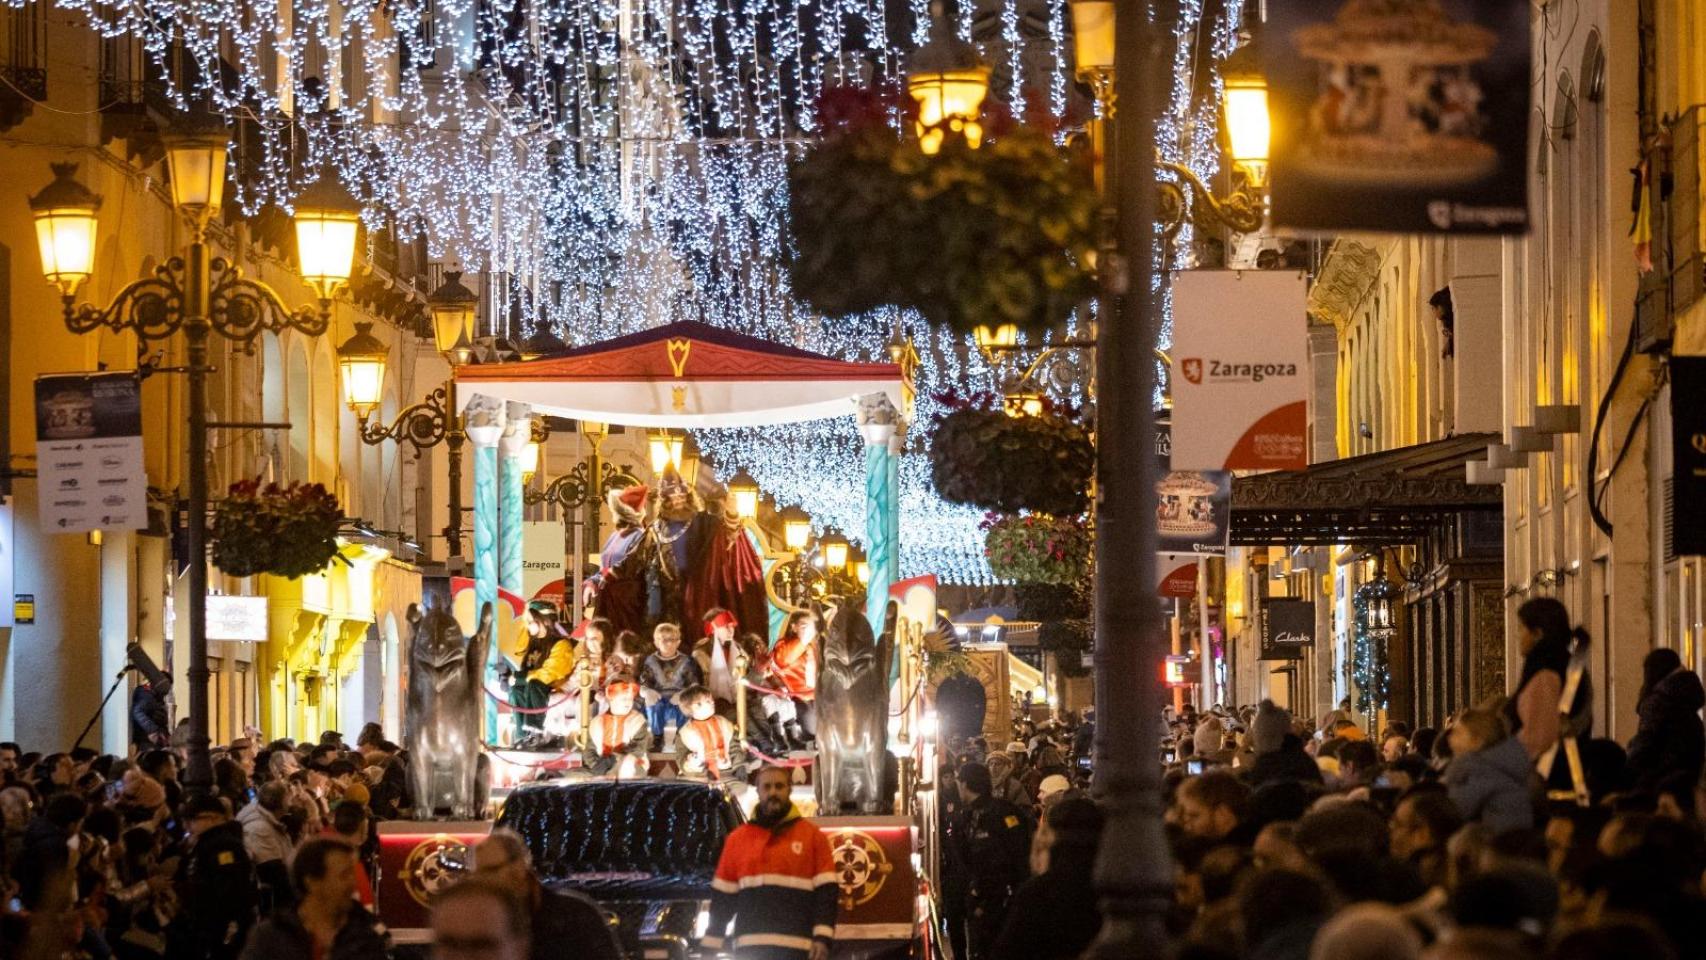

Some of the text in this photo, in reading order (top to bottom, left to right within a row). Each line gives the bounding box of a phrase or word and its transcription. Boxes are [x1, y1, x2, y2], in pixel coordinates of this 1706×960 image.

[1210, 361, 1297, 382] Zaragoza
[522, 561, 560, 570] Zaragoza
[1275, 631, 1311, 643] Clarks
